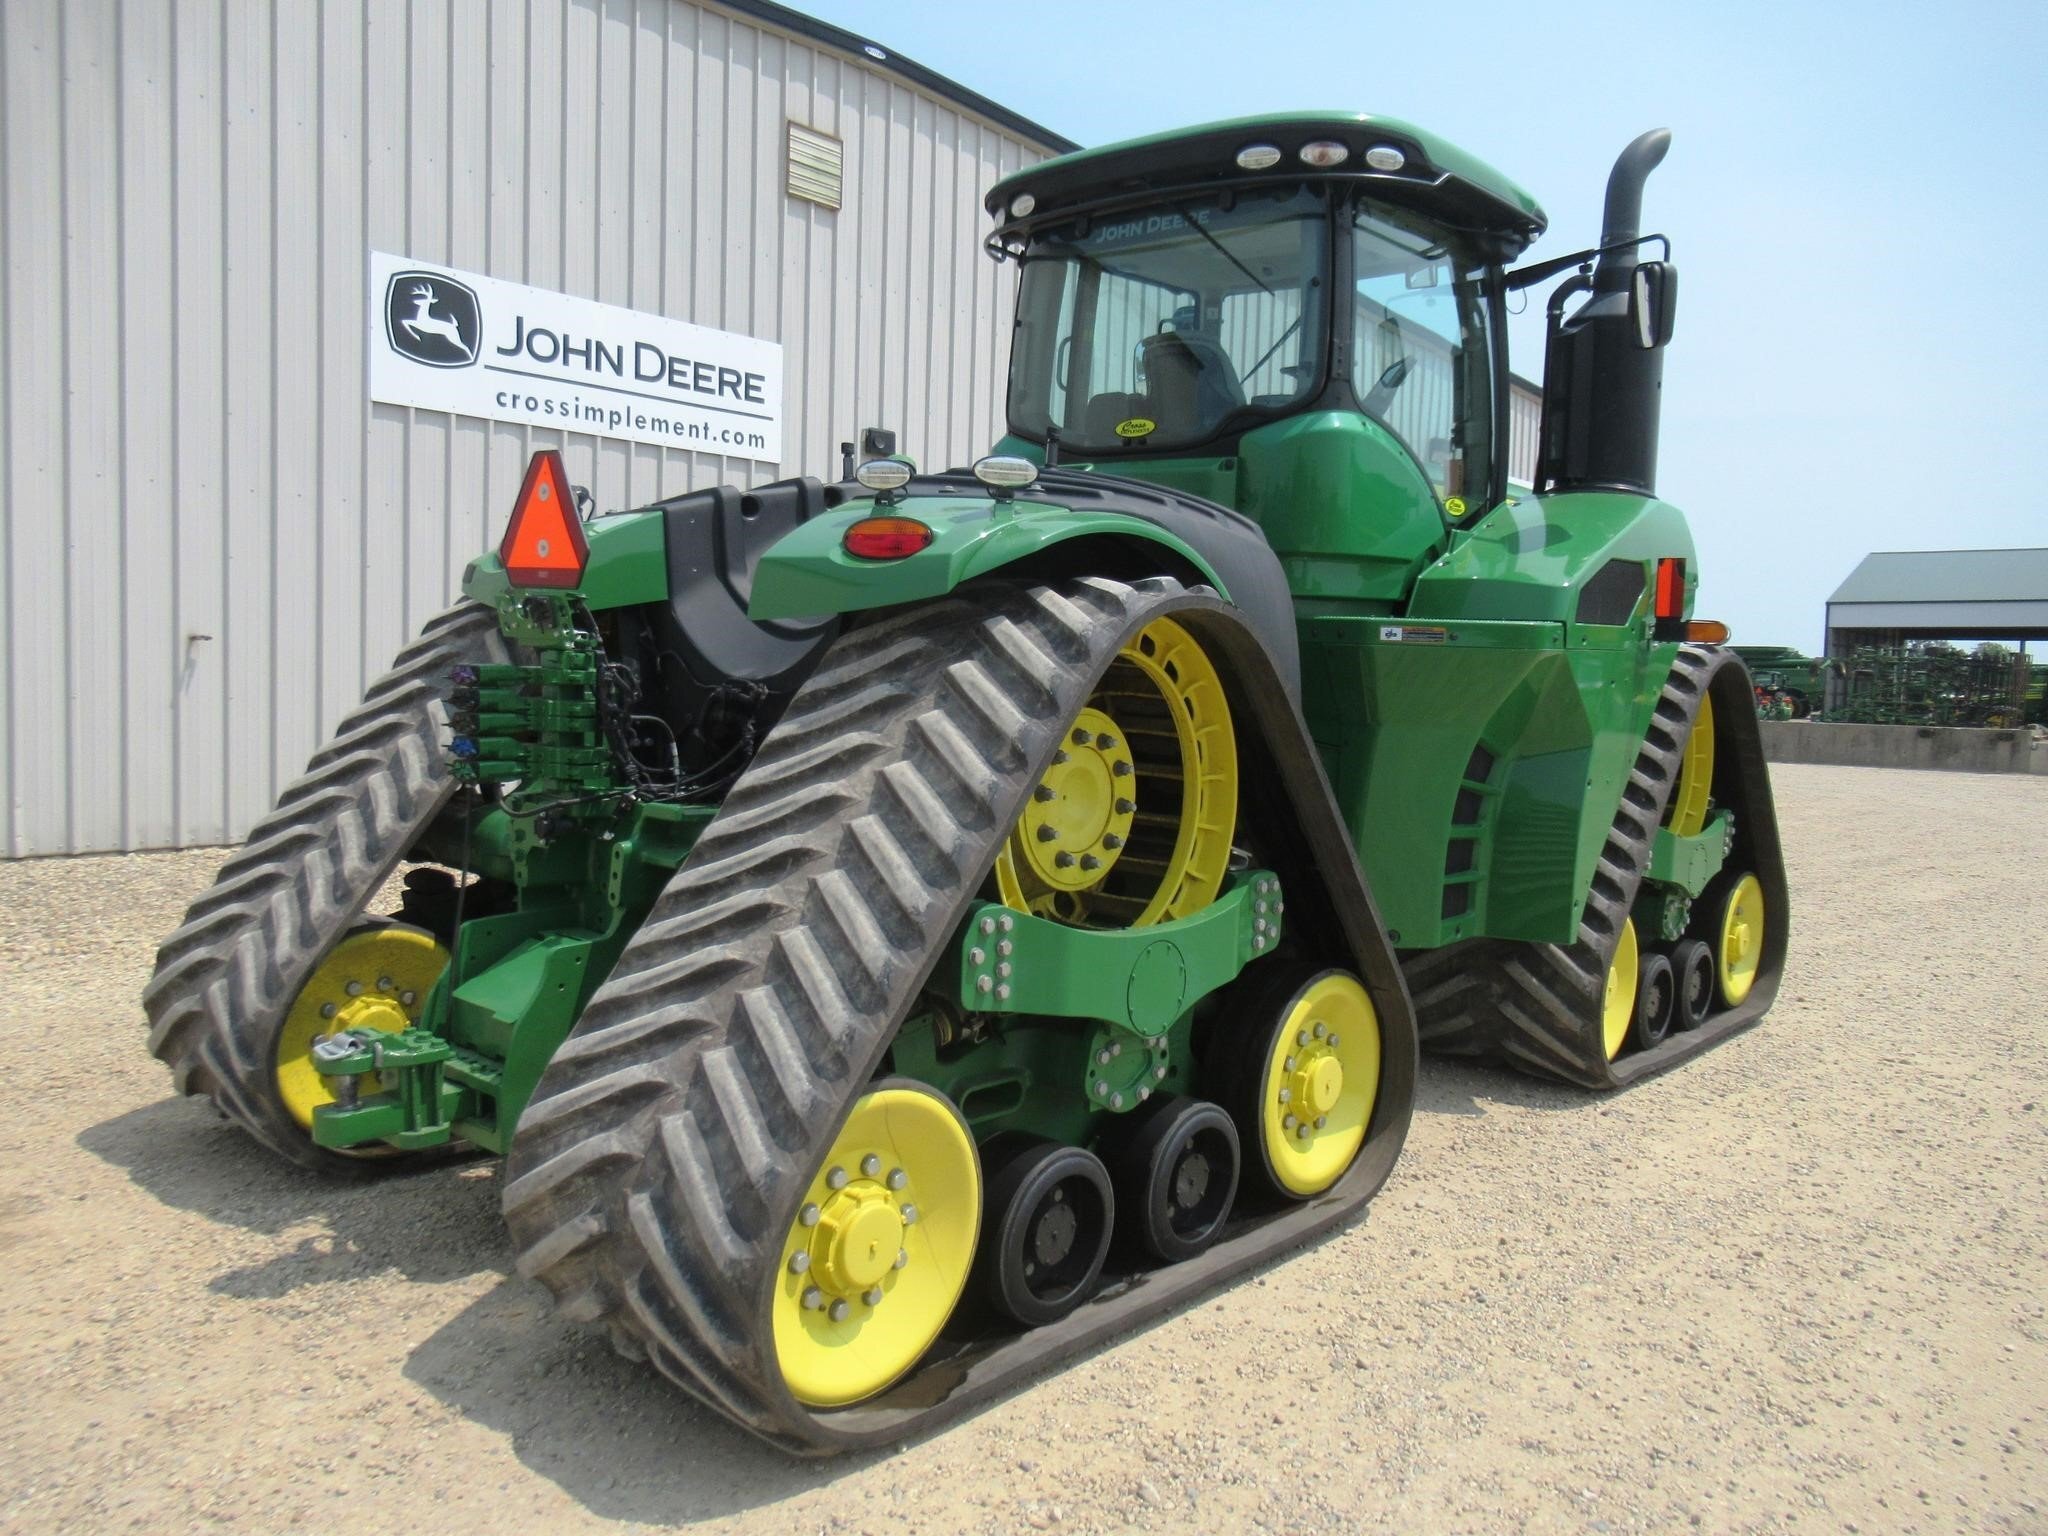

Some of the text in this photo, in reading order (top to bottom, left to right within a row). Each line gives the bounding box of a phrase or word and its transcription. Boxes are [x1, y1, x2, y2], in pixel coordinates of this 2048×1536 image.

[1096, 221, 1143, 243] JOHN
[496, 315, 766, 404] JOHN DEERE
[496, 391, 765, 449] crossimplement.com
